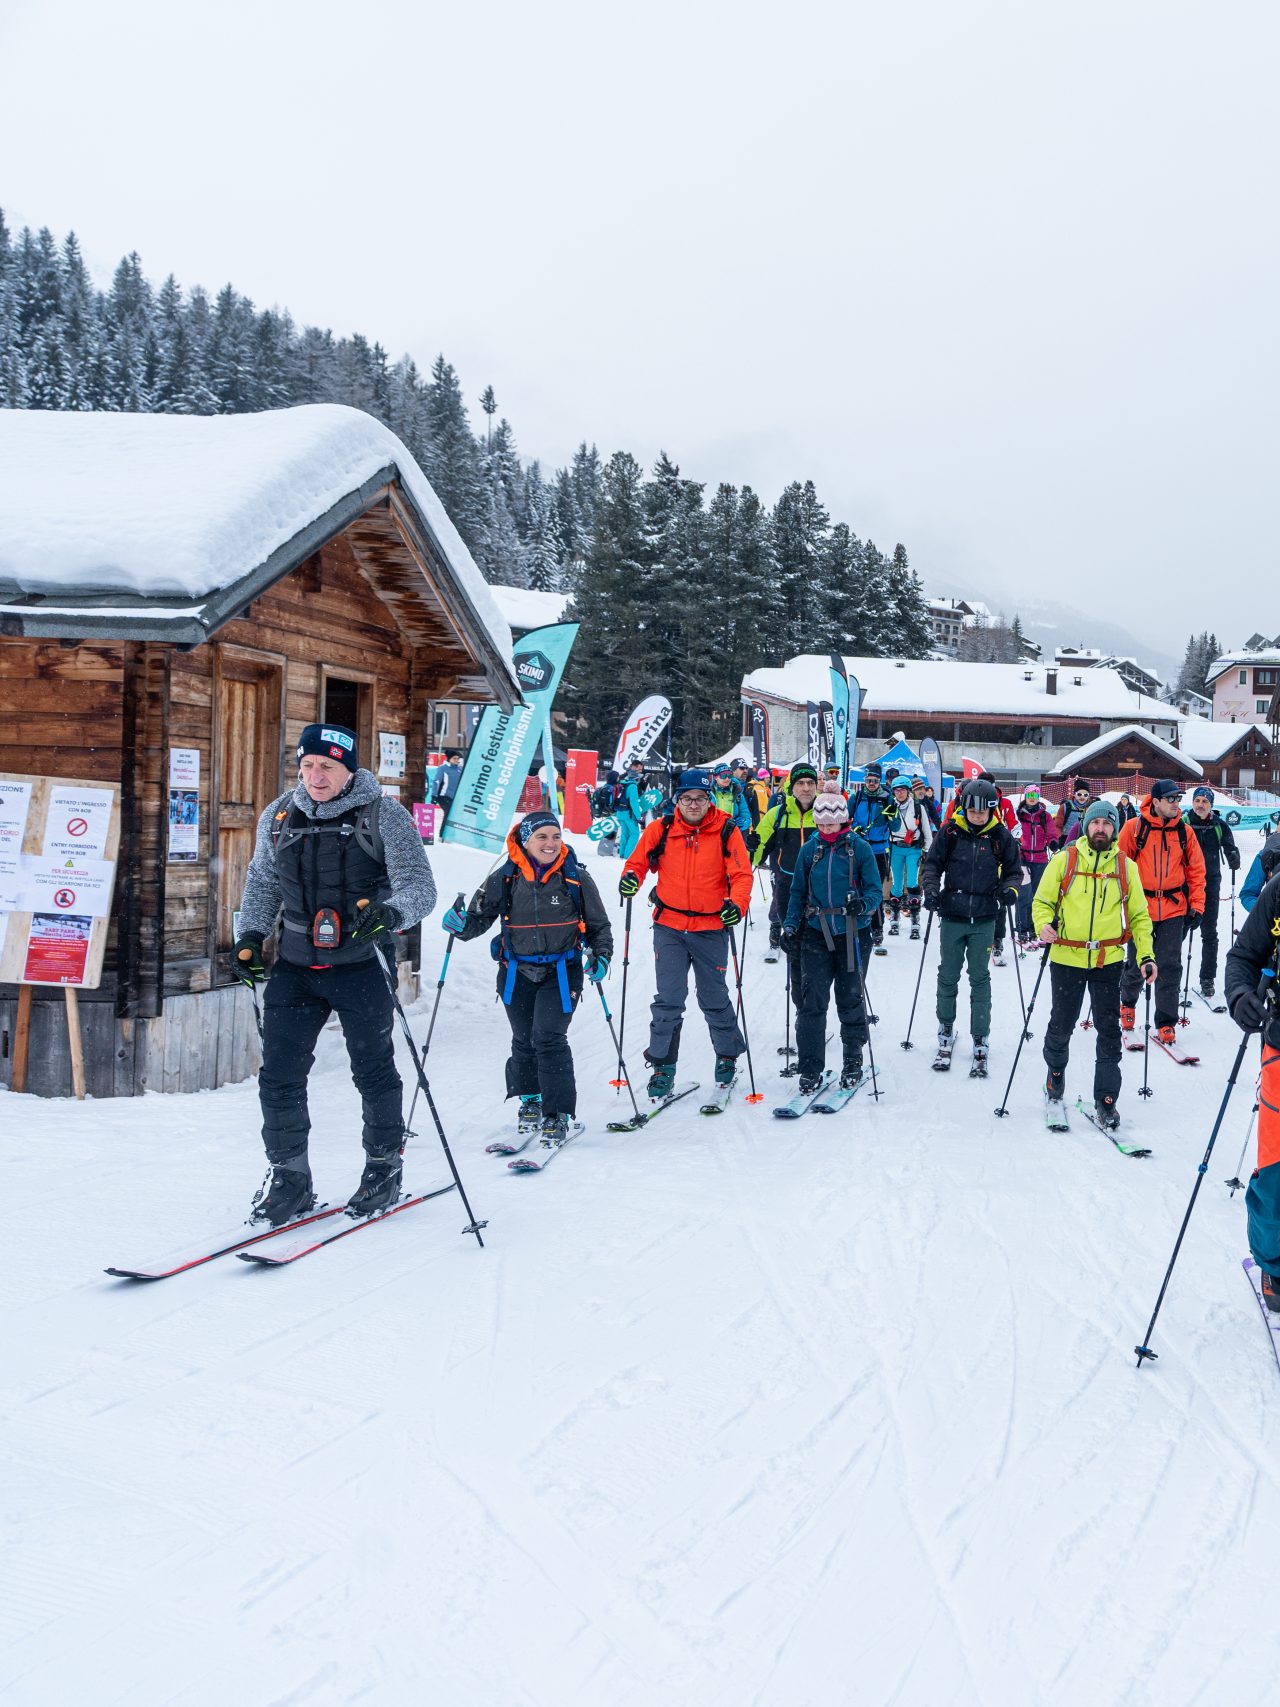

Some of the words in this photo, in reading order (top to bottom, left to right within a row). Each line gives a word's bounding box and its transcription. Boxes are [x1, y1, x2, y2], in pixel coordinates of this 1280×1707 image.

[518, 663, 545, 681] SKIMO
[622, 706, 672, 771] caterina
[483, 781, 506, 822] dello
[497, 701, 536, 786] scialpinismo
[470, 764, 493, 806] primo
[463, 804, 478, 815] Il
